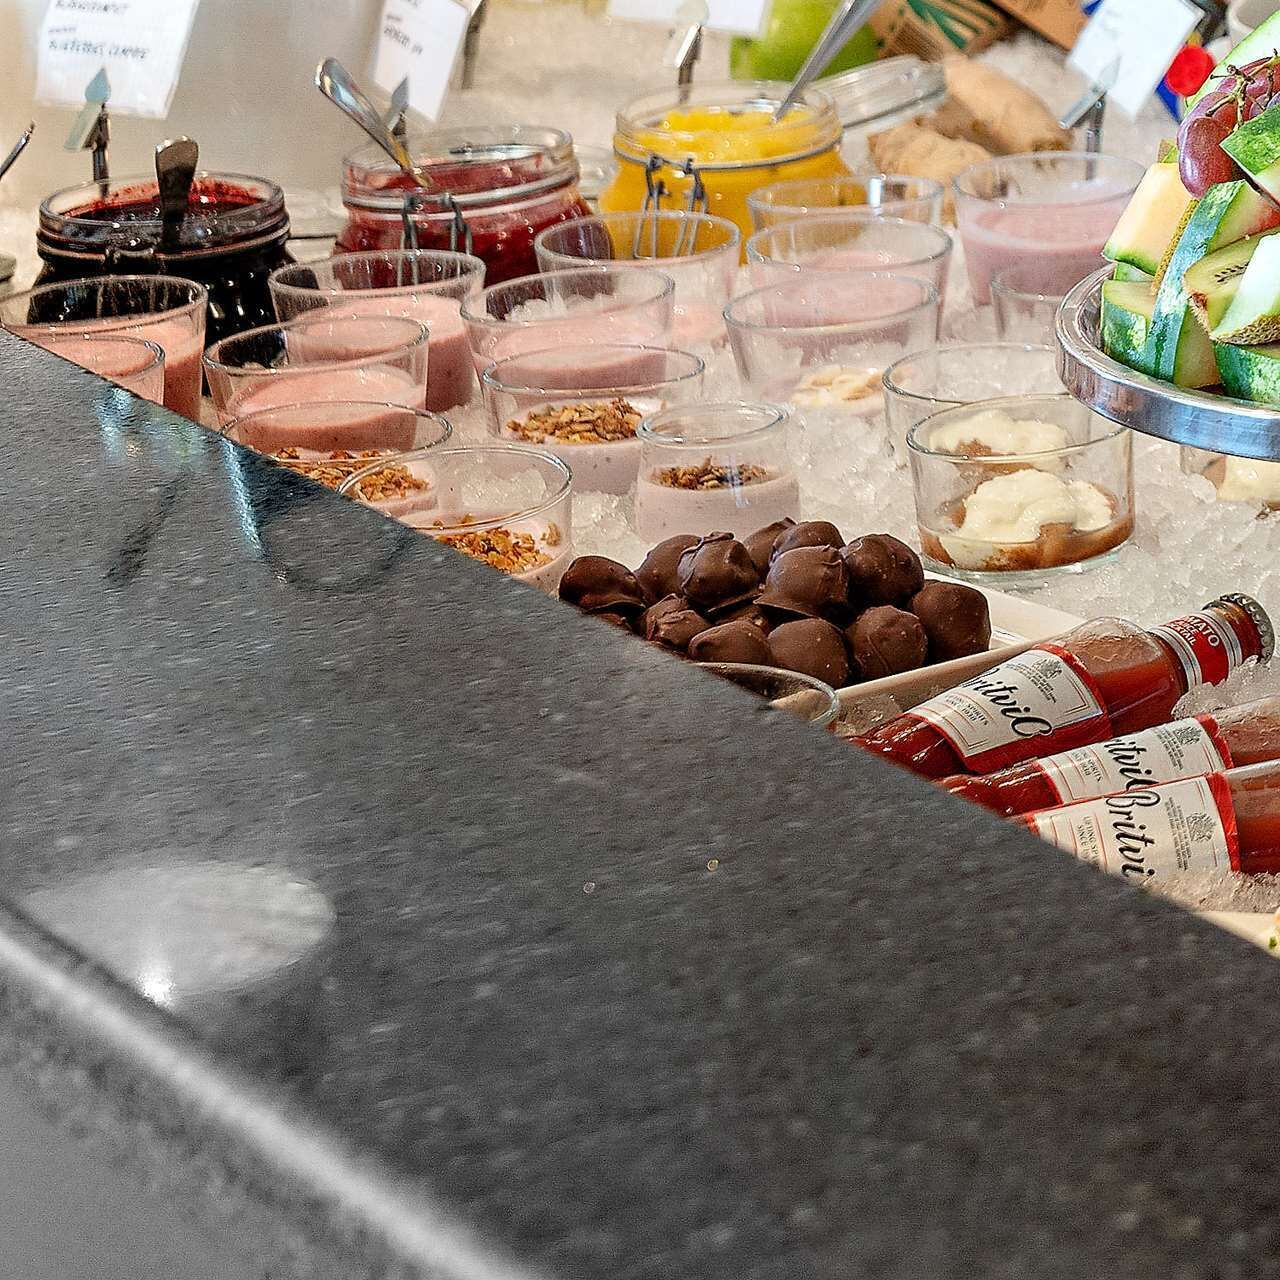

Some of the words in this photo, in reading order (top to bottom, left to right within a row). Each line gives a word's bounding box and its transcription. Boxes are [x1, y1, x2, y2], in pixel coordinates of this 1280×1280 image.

[1186, 615, 1220, 647] MATO
[1103, 739, 1160, 792] itvic
[1104, 790, 1161, 878] Britvi
